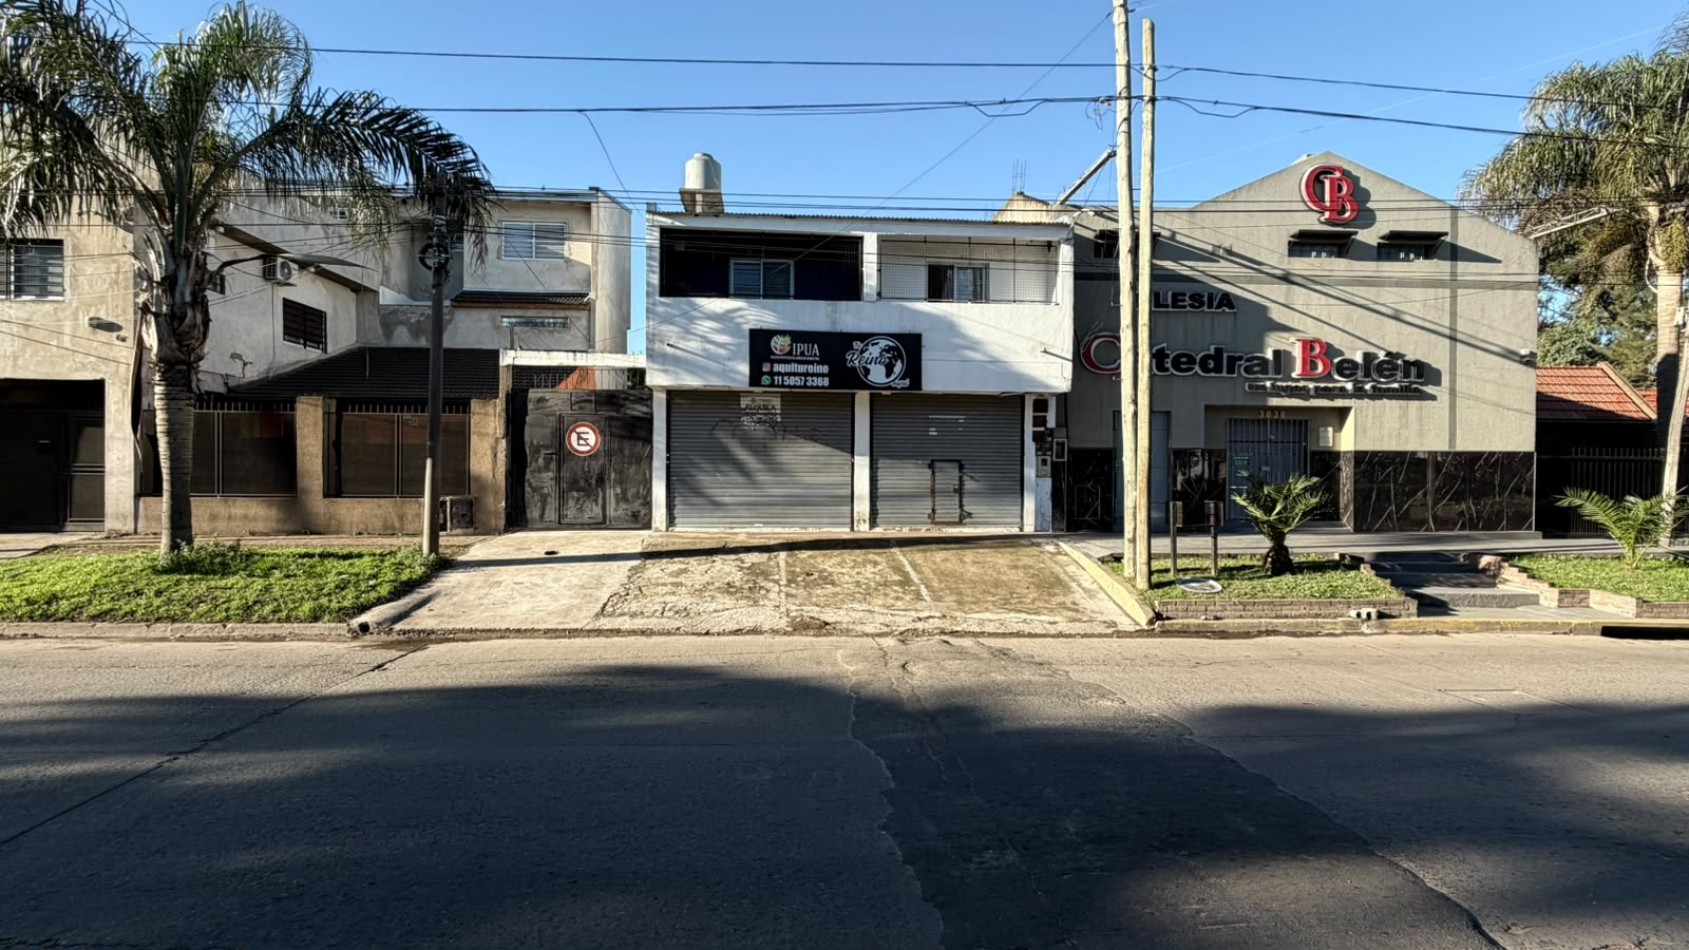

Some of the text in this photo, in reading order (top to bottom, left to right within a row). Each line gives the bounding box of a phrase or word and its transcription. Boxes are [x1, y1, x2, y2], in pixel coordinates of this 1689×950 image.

[1137, 291, 1236, 311] LESIA
[793, 343, 820, 356] IPUA
[846, 351, 888, 366] Reino
[1080, 332, 1426, 382] Ctedral Belén
[773, 362, 829, 374] aquitureino
[774, 376, 829, 387] 11 5057 3368
[577, 432, 589, 446] E
